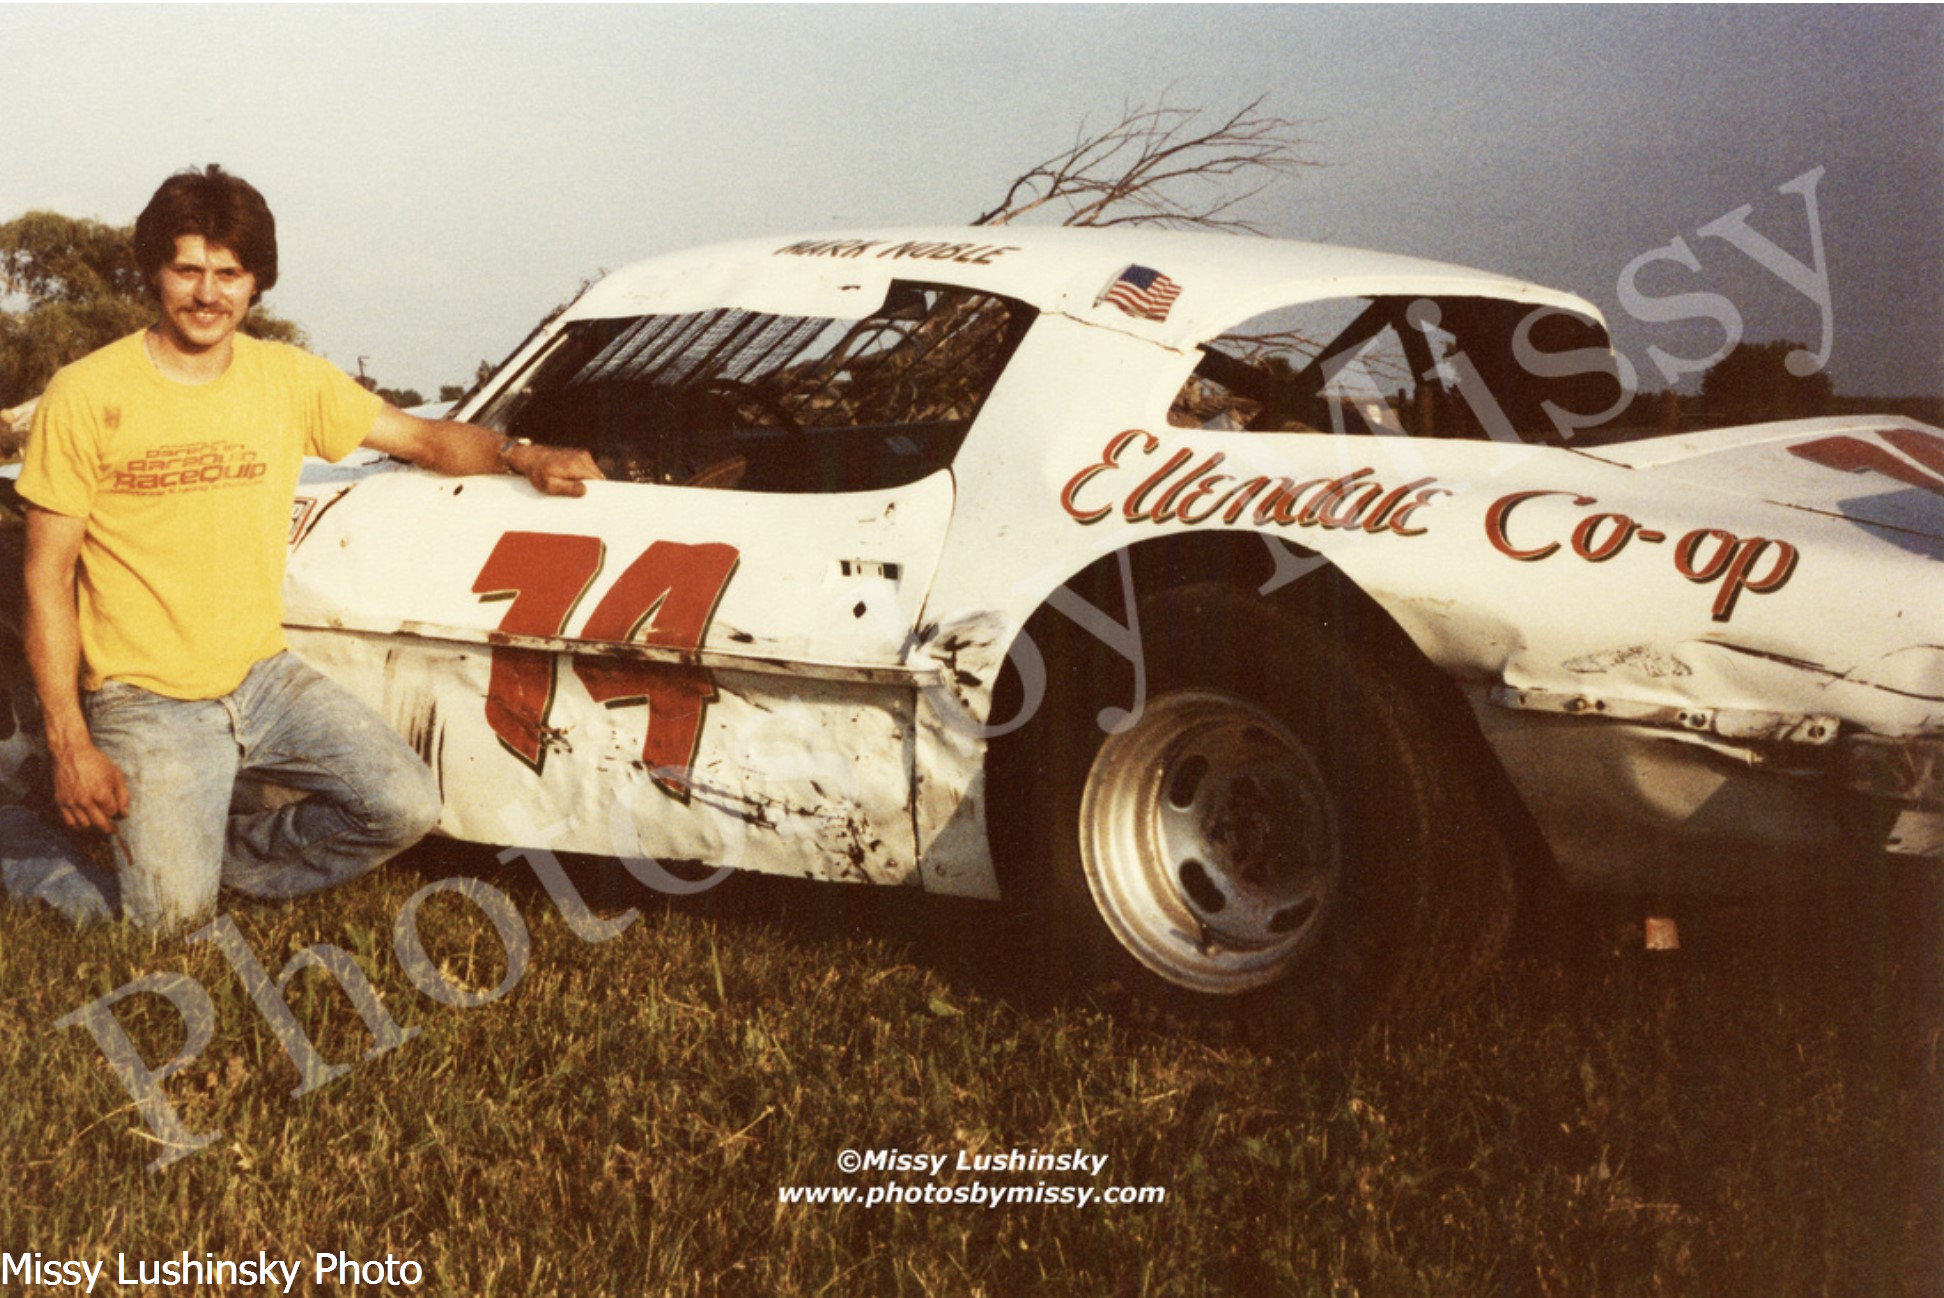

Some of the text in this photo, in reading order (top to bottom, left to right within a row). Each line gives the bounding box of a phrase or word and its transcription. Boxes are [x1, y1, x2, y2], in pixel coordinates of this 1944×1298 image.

[772, 239, 1022, 265] MARK NOBLE
[113, 463, 267, 489] RaceQuip
[1060, 429, 1800, 623] Ellendale Co-op
[470, 530, 741, 808] 74
